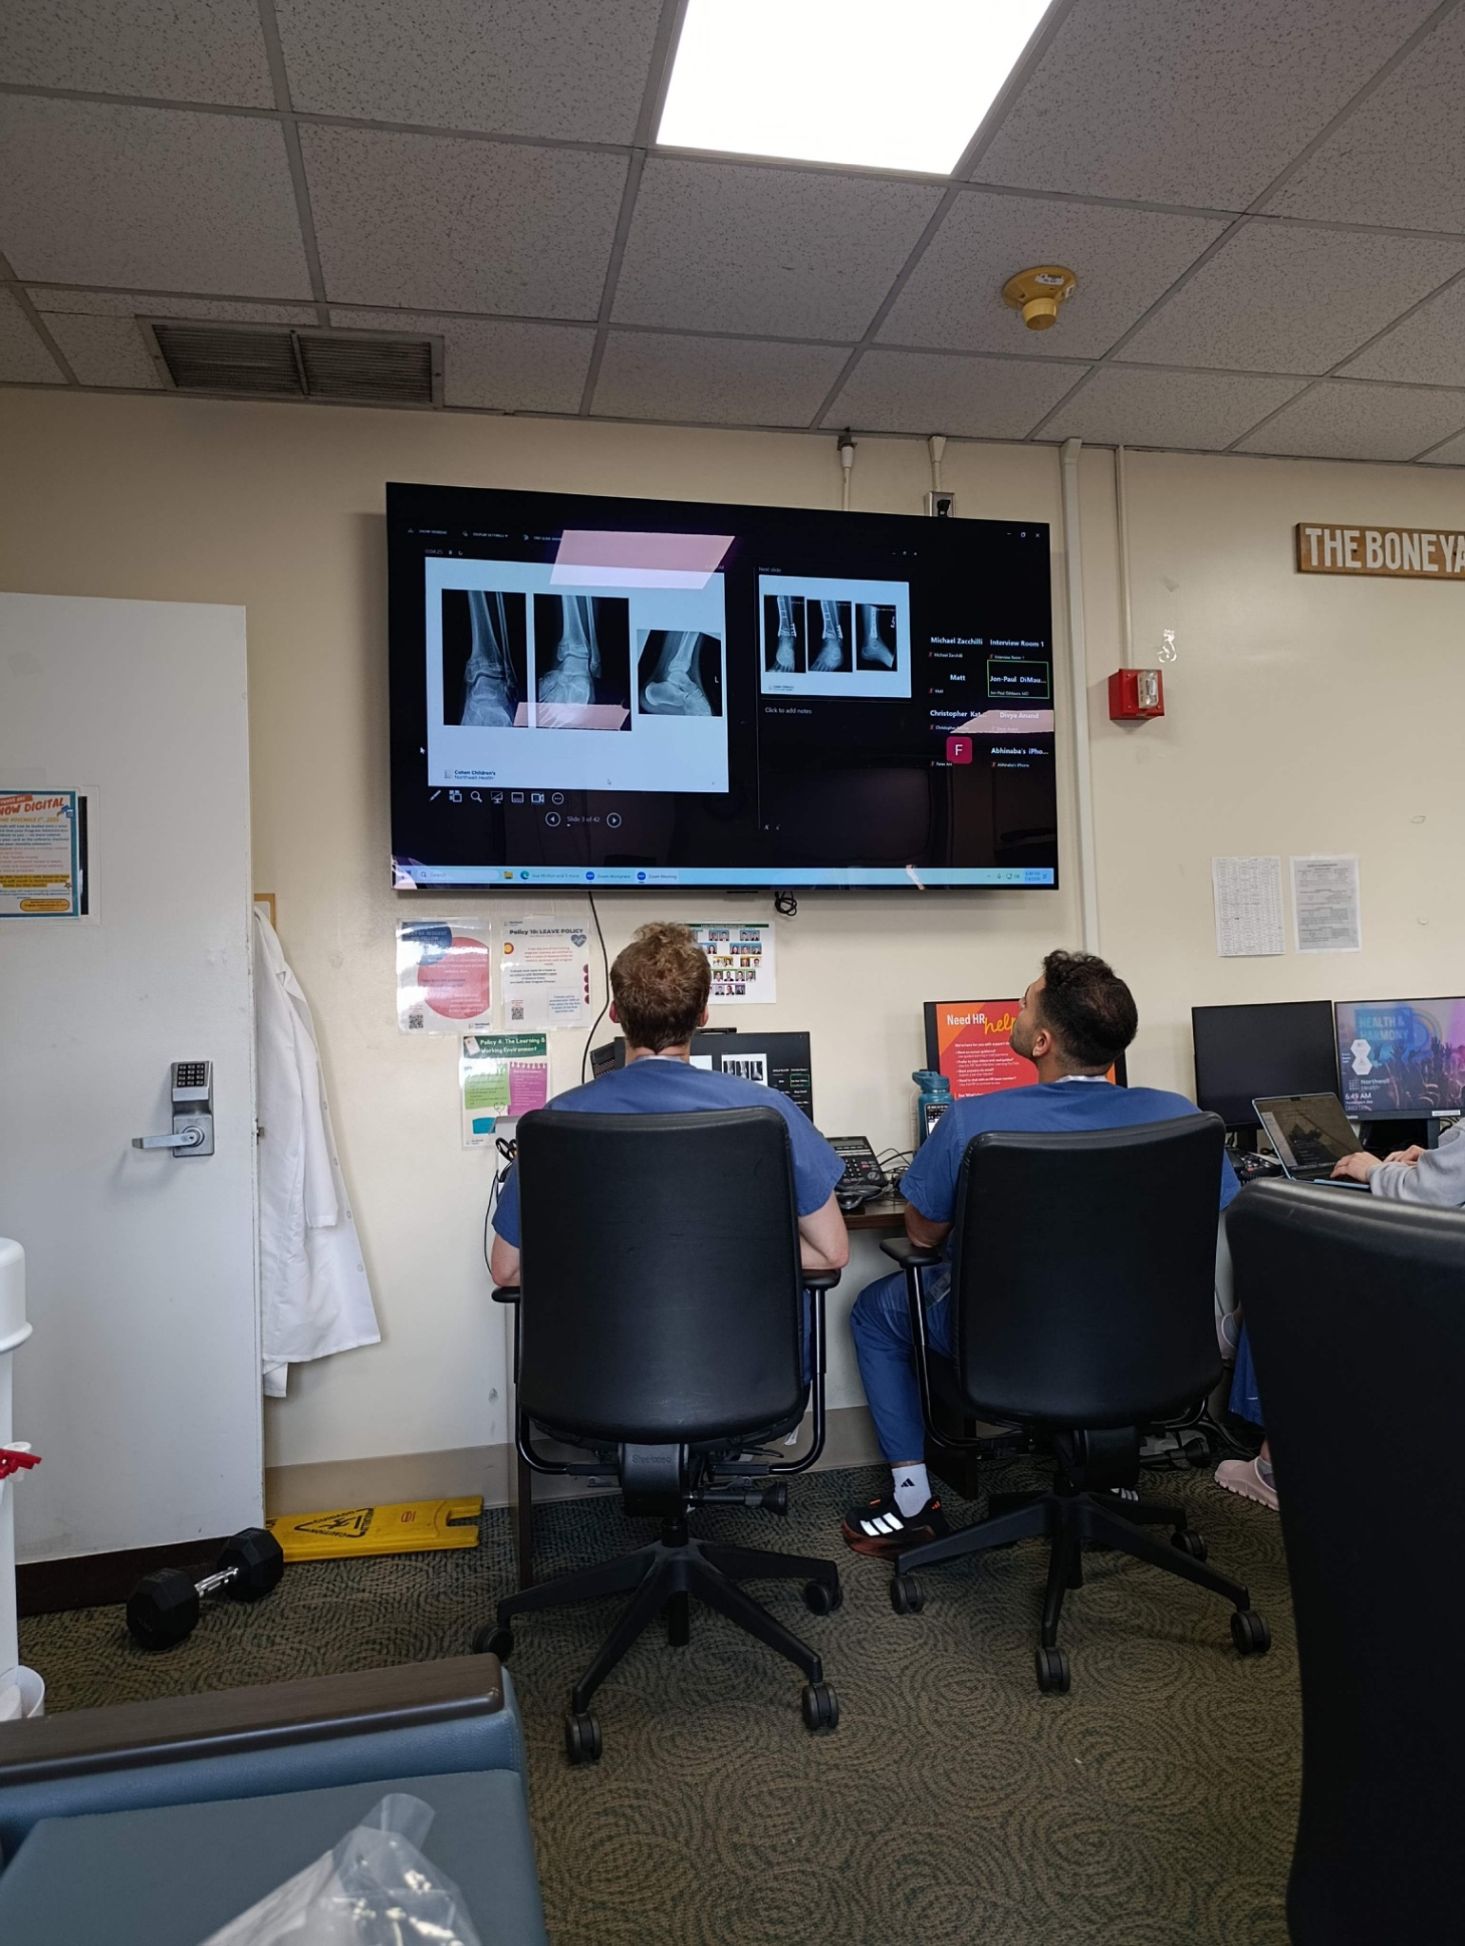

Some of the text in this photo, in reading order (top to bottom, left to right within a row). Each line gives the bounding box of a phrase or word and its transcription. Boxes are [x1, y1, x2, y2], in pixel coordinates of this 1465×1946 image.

[1305, 527, 1362, 568] THE
[990, 639, 1019, 647] Interview
[990, 675, 1017, 683] Jon-Paul
[929, 710, 968, 718] Christopher
[955, 744, 963, 756] F
[0, 803, 21, 816] NOW
[24, 797, 65, 813] DIGITAL
[946, 1013, 971, 1025] Need
[972, 1012, 985, 1024] HR
[1359, 1015, 1396, 1028] HEALTH
[516, 1037, 540, 1045] Learning
